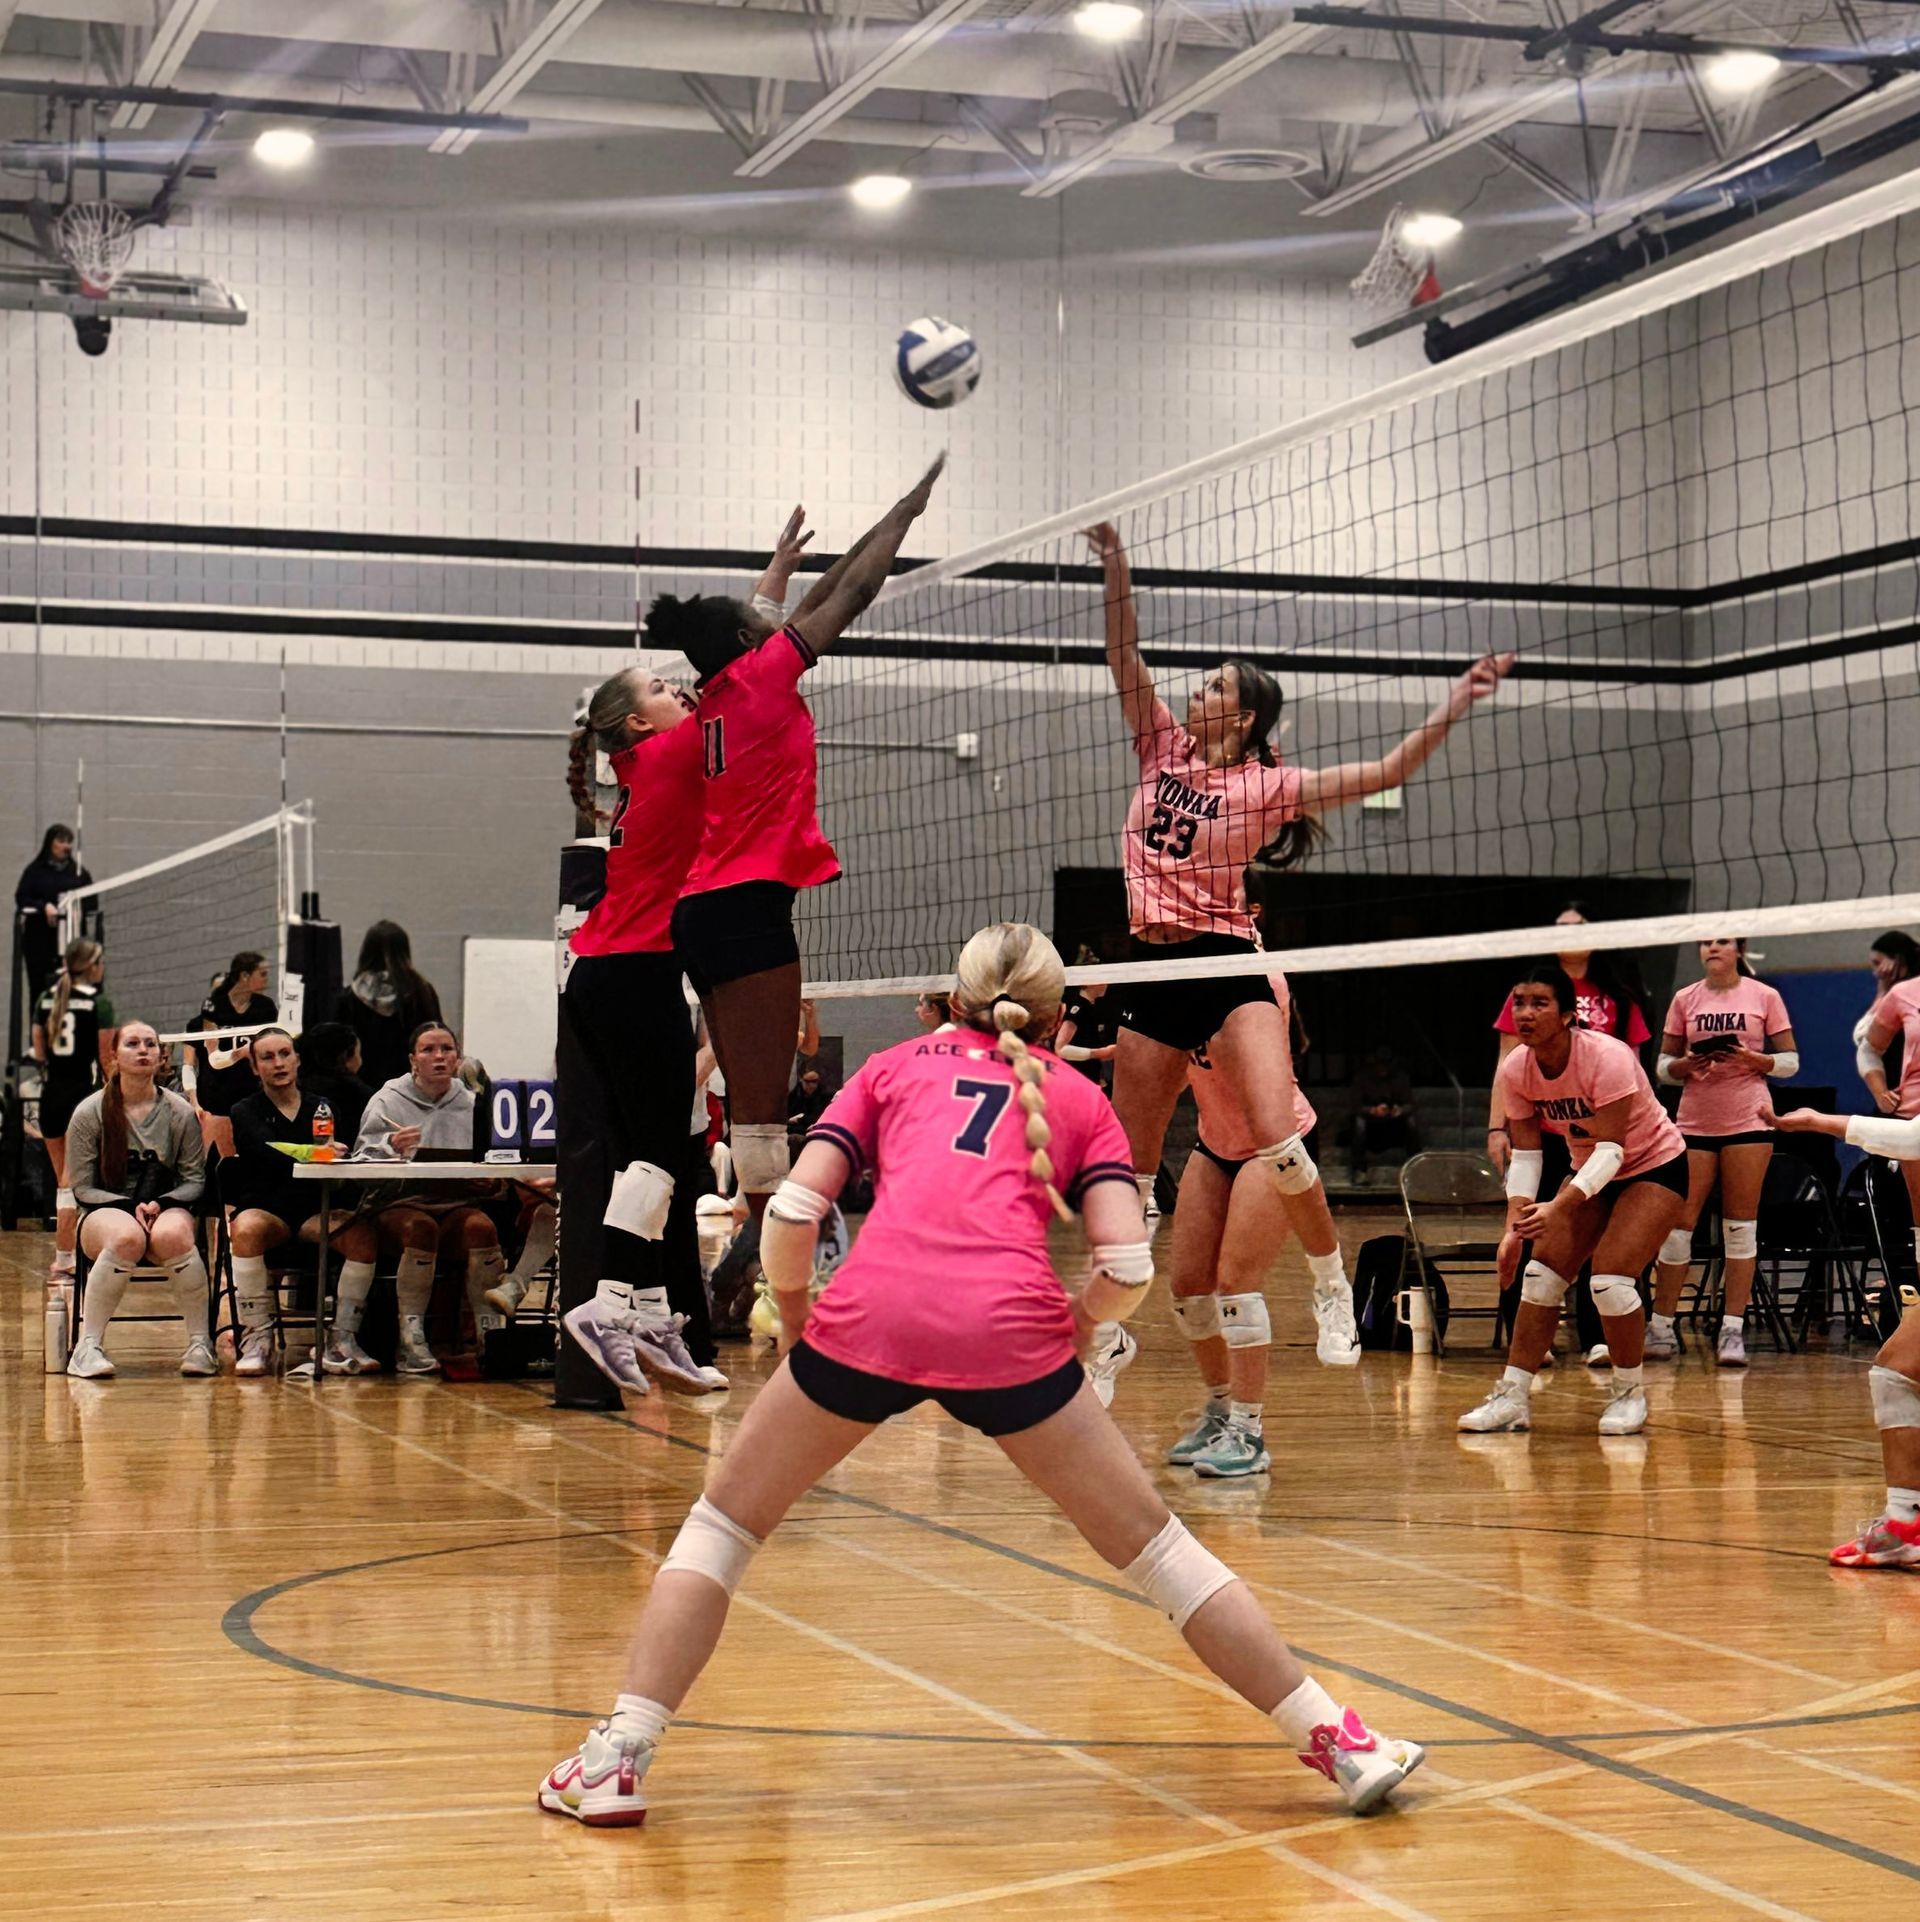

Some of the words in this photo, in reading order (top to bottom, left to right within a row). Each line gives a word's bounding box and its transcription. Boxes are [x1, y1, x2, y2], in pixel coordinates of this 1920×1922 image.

[703, 715, 725, 780] 11
[1155, 770, 1222, 819] TONKA
[1146, 807, 1198, 859] 23
[1697, 1013, 1747, 1032] TONKA
[915, 1044, 964, 1057] ACE
[952, 1075, 1014, 1160] 7
[1535, 1097, 1596, 1120] TONKA
